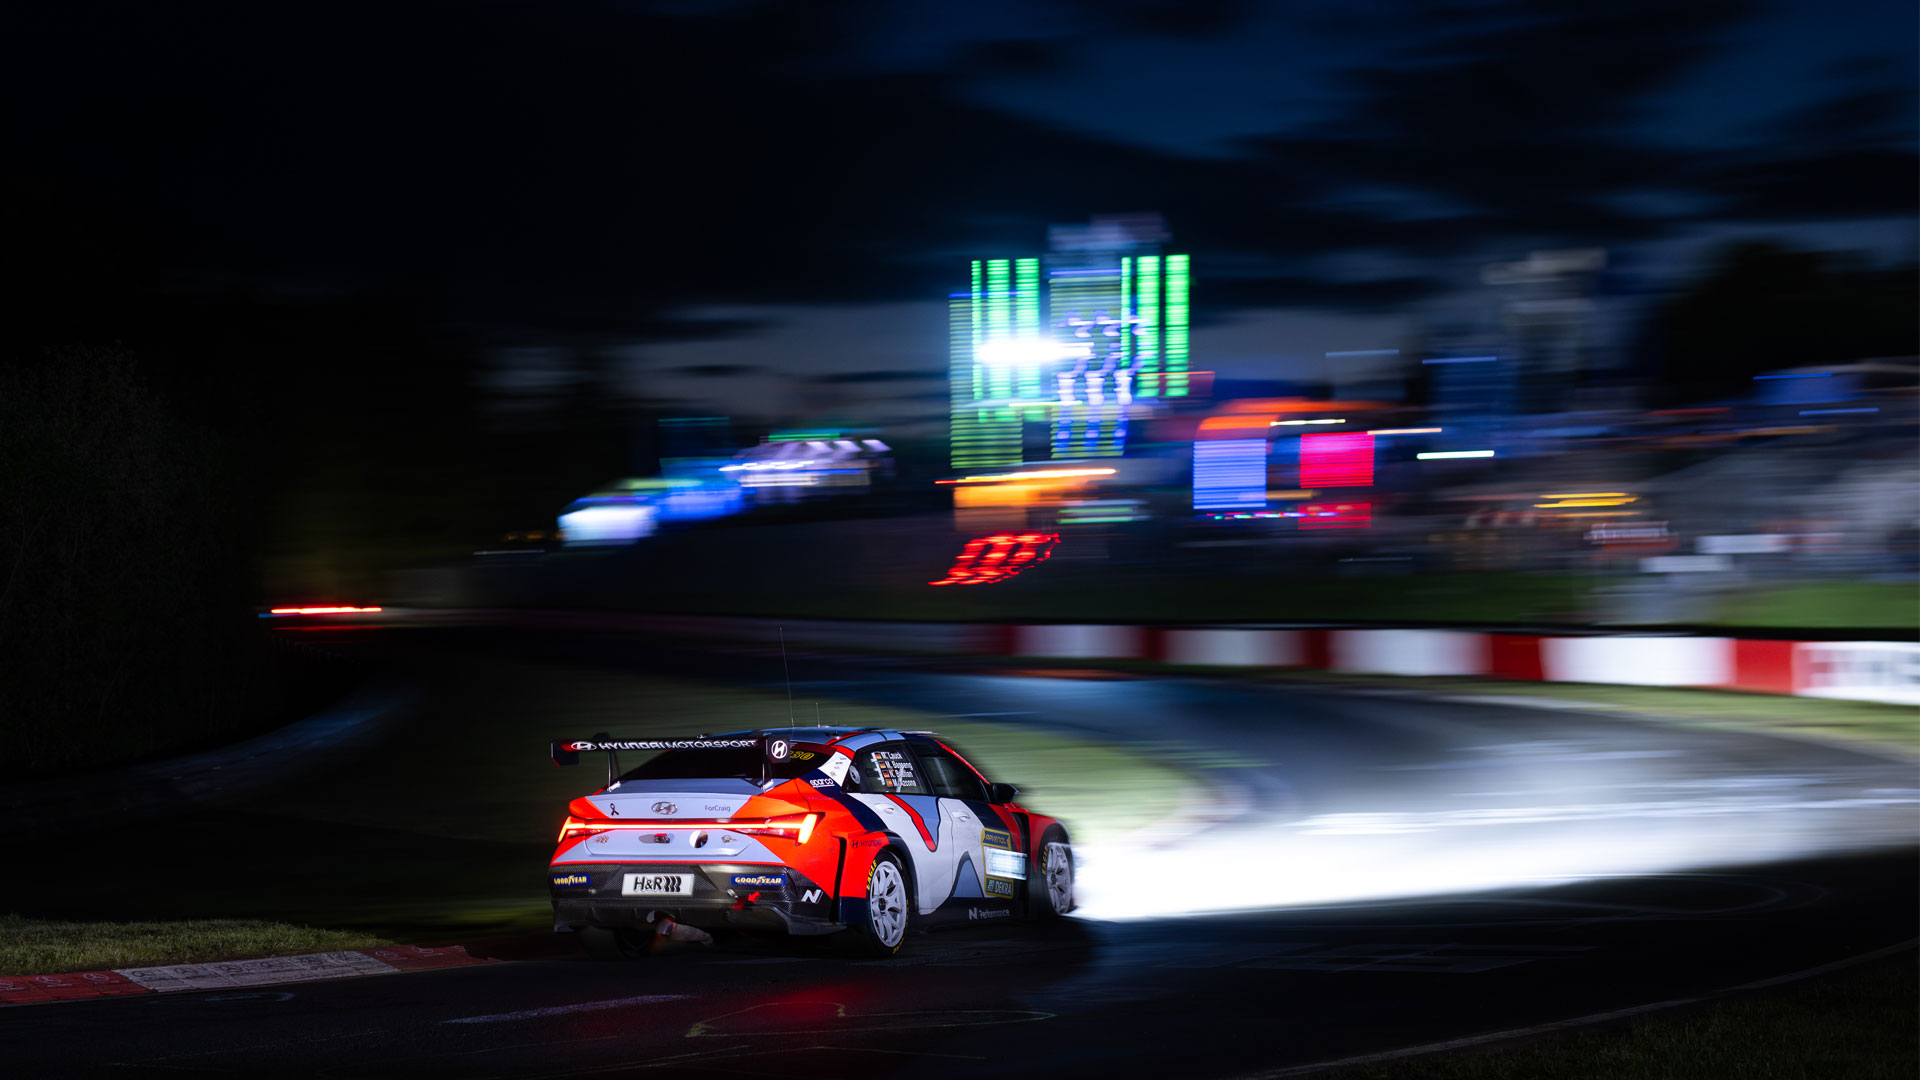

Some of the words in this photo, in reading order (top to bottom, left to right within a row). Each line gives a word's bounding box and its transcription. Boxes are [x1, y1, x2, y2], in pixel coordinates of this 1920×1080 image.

[665, 740, 757, 749] MOTORSPORT
[810, 778, 835, 787] sparco
[704, 804, 731, 812] ForCraig
[734, 875, 782, 886] GOODYEAR
[866, 859, 877, 891] EAGLE
[633, 876, 662, 891] H&R
[994, 881, 1012, 895] DEKRA
